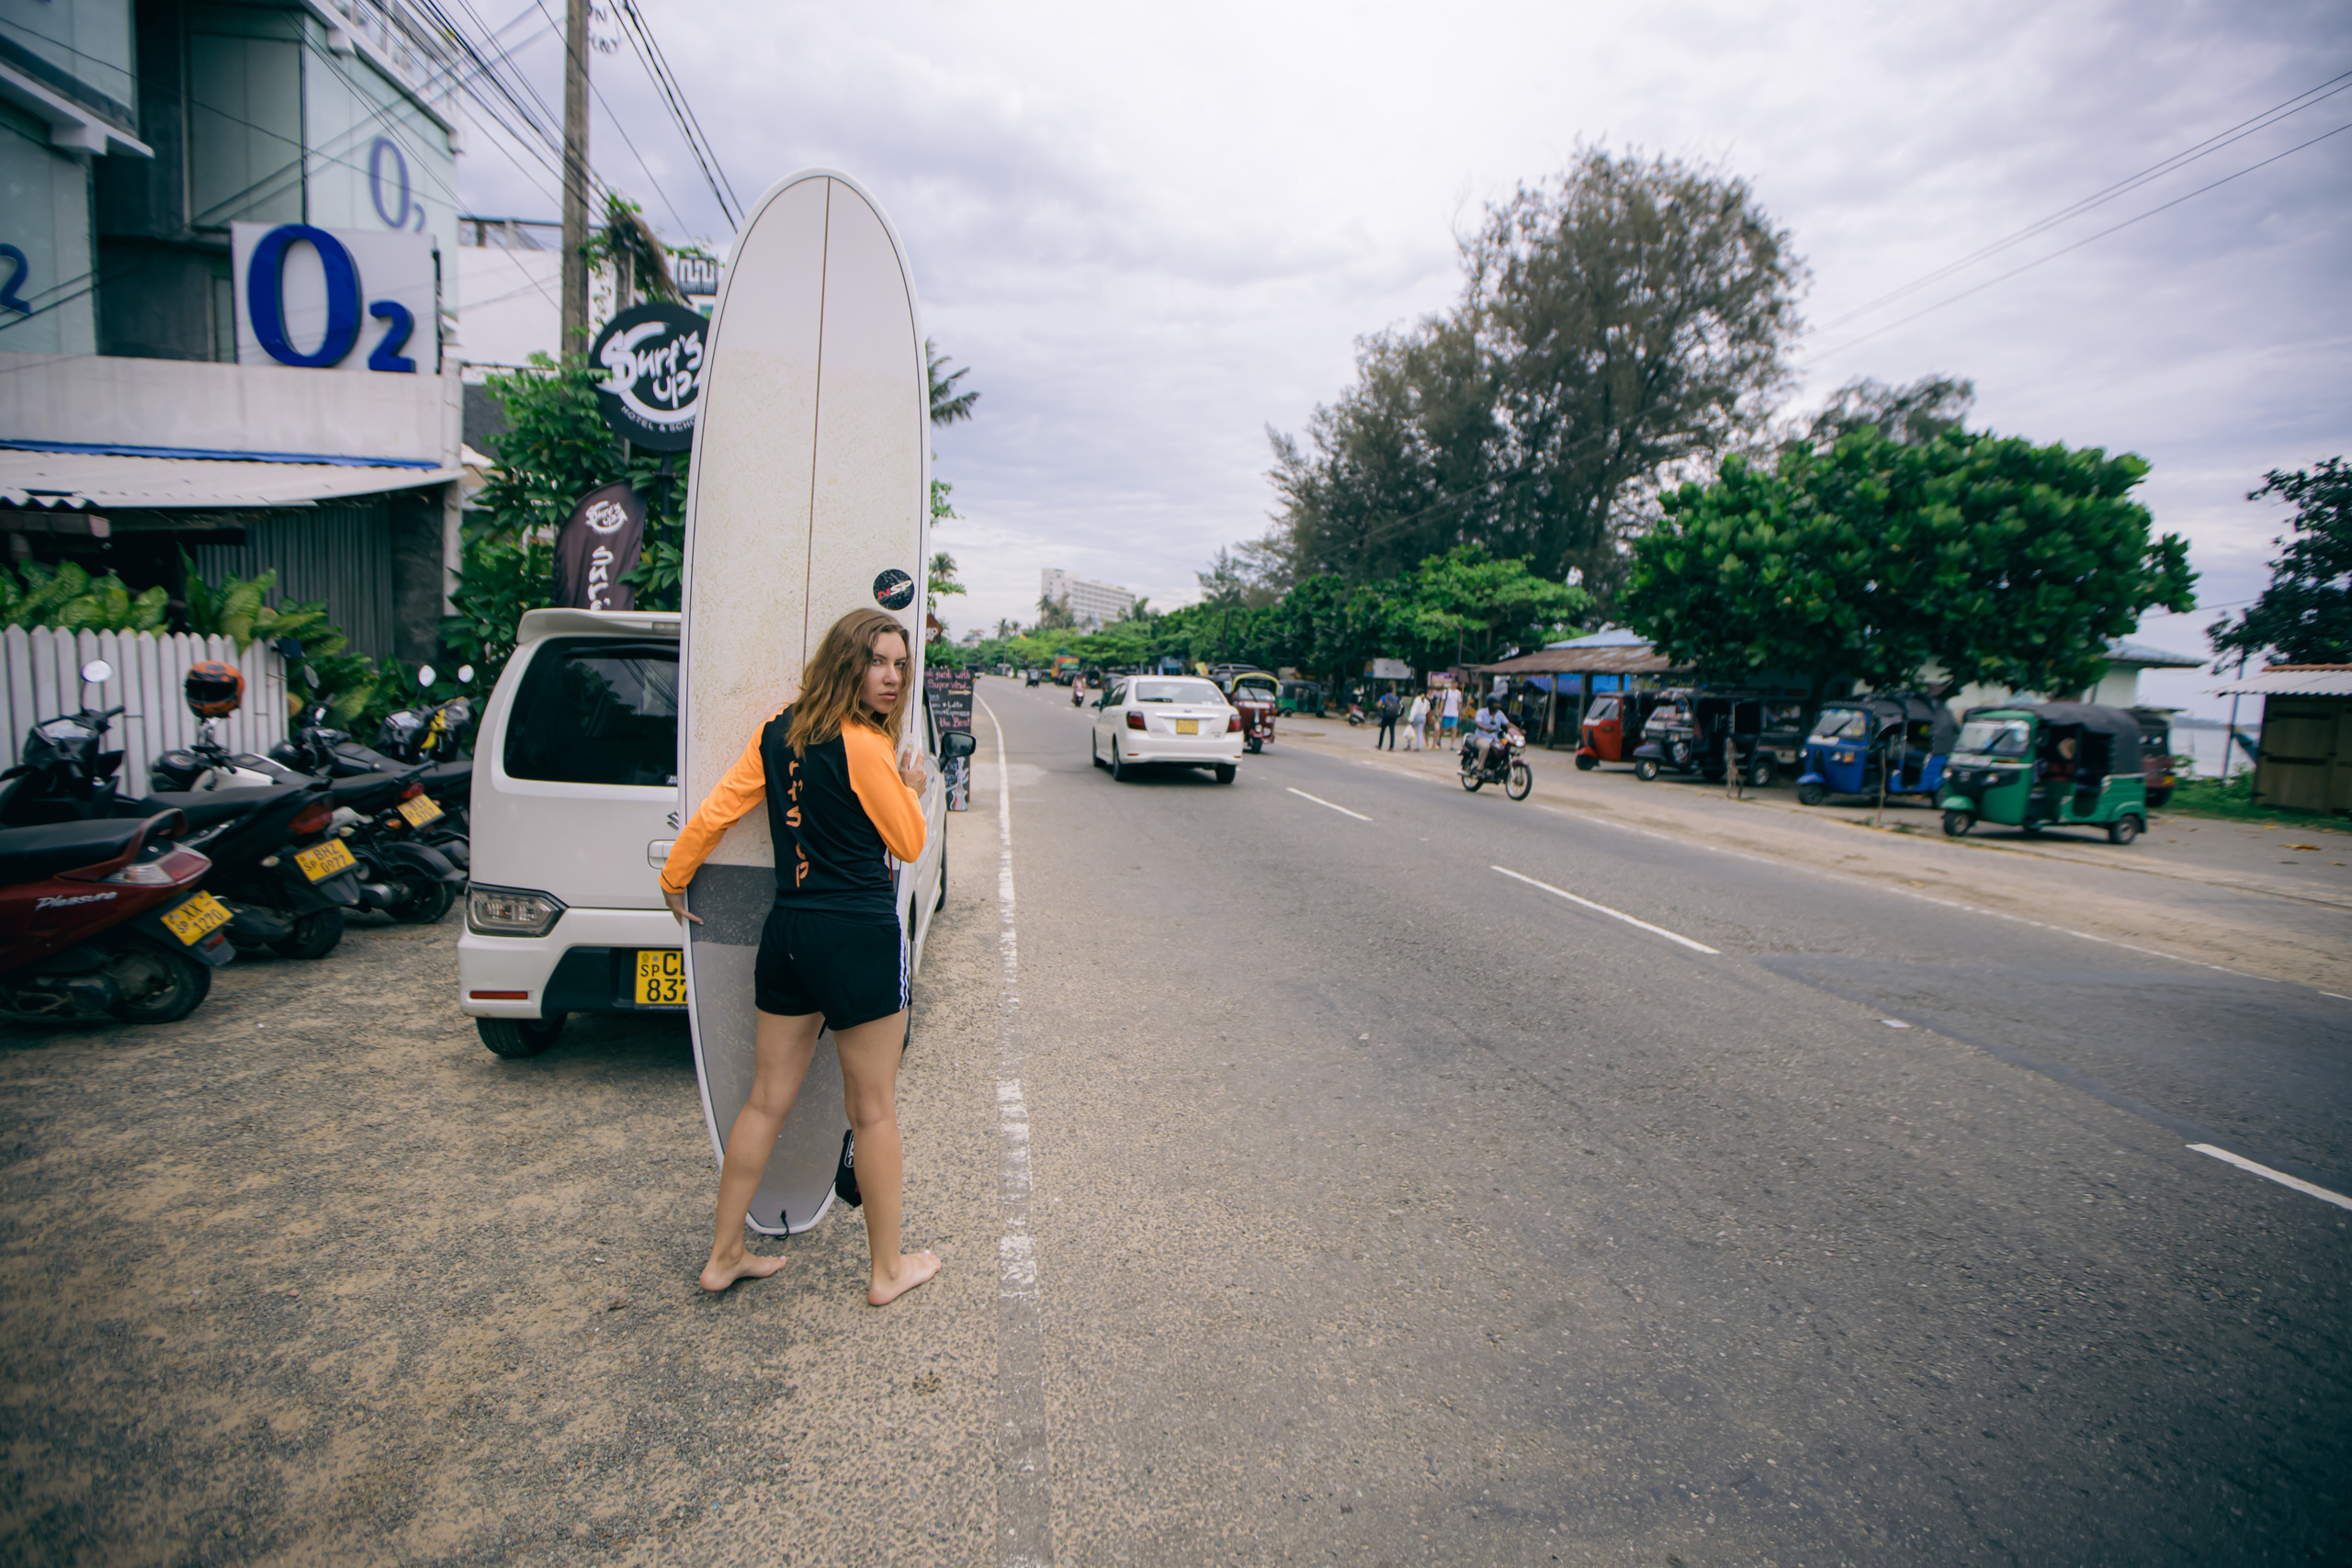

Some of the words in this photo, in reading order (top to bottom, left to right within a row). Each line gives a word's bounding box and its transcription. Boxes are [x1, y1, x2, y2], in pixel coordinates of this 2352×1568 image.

[620, 405, 654, 431] HOTEL
[659, 423, 666, 434] &
[877, 580, 911, 600] NSP
[955, 669, 970, 679] with
[939, 716, 951, 728] the
[953, 716, 970, 728] Best
[313, 842, 340, 861] BHZ
[303, 860, 316, 872] SP
[320, 854, 346, 873] 0977
[175, 920, 189, 933] SP
[192, 908, 224, 933] 1270
[640, 964, 660, 976] SP
